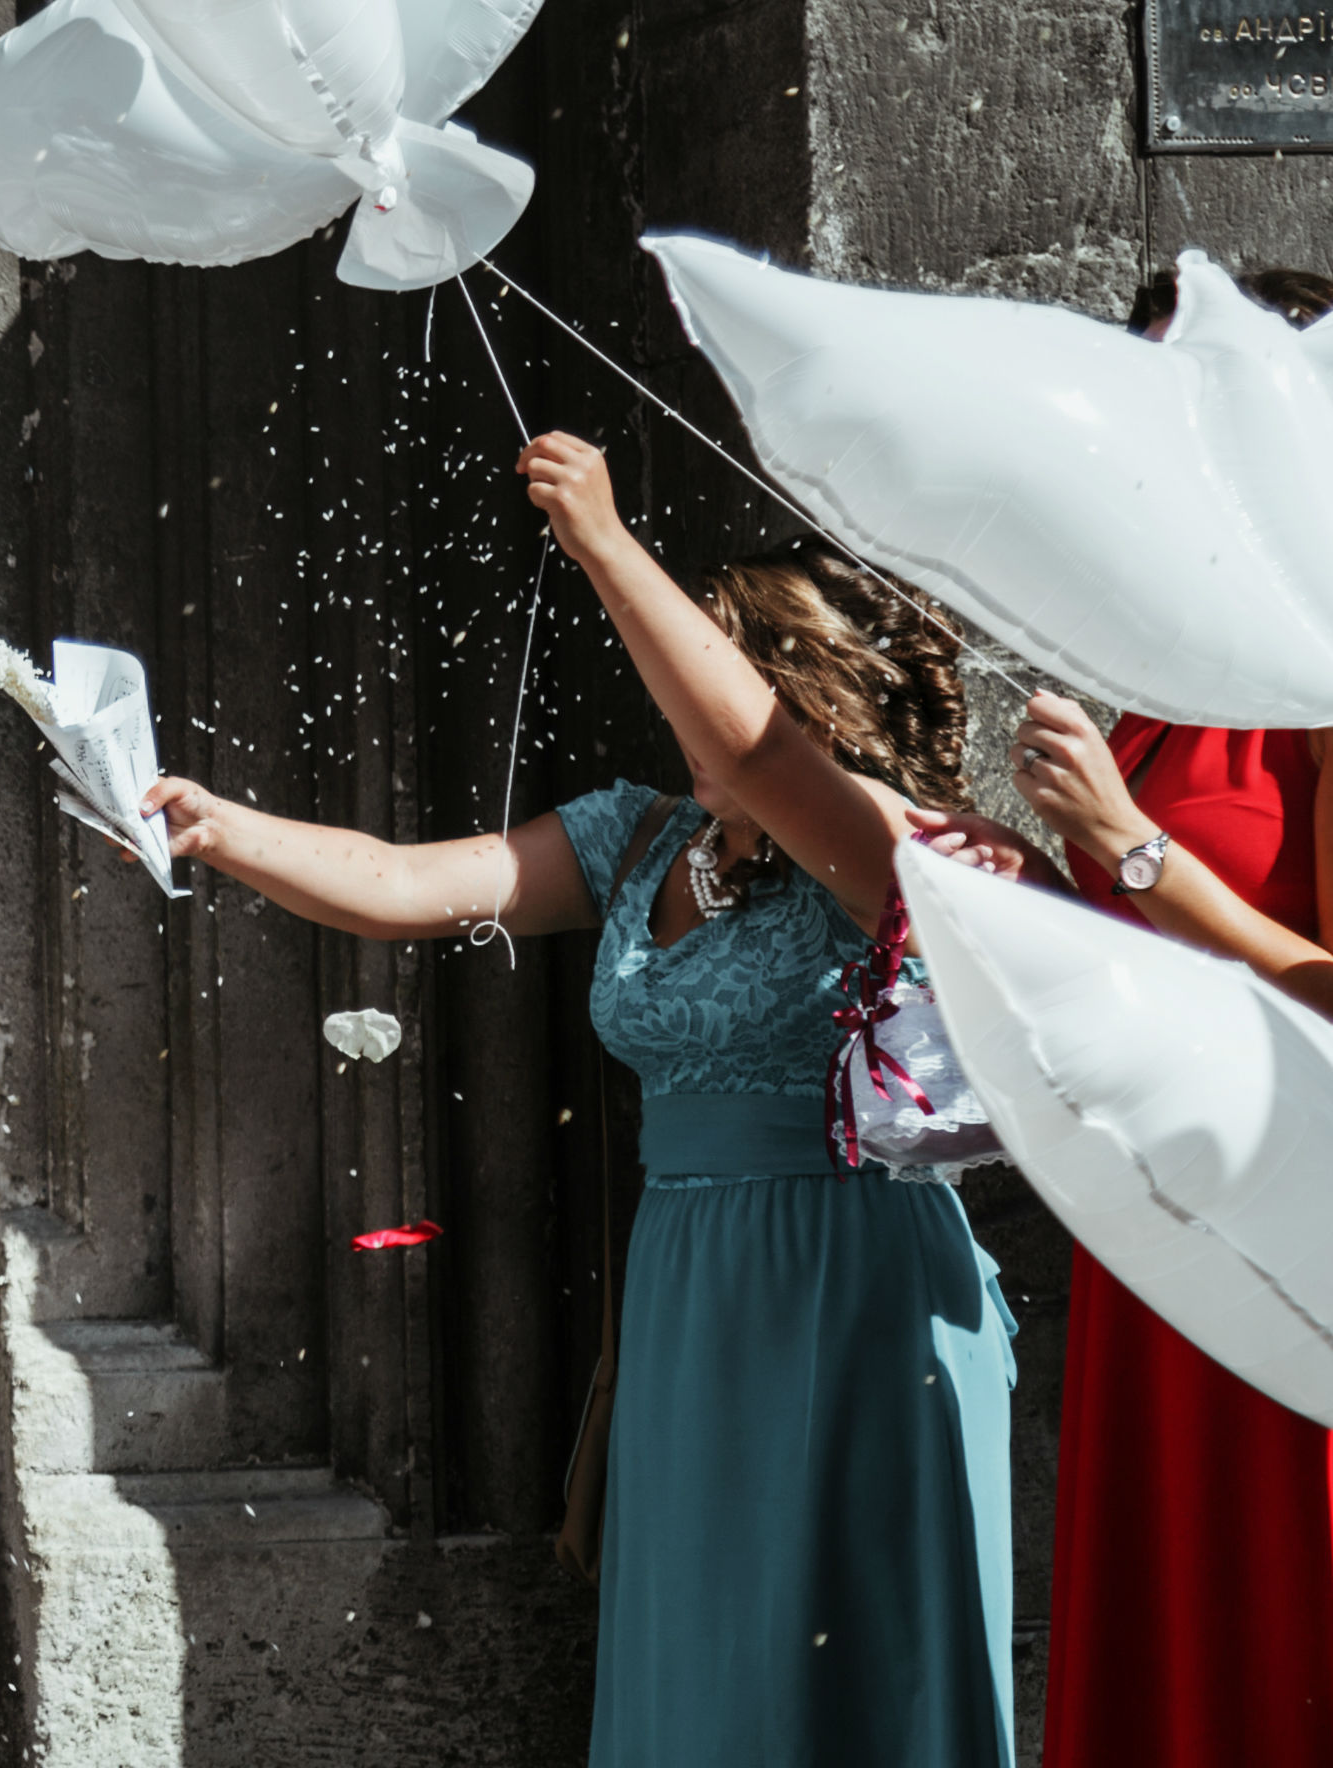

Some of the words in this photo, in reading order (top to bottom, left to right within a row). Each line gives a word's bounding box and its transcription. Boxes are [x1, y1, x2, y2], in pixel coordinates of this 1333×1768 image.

[1200, 28, 1228, 42] св.
[1235, 11, 1333, 43] АНДРІ
[1265, 72, 1333, 99] ЧСВ
